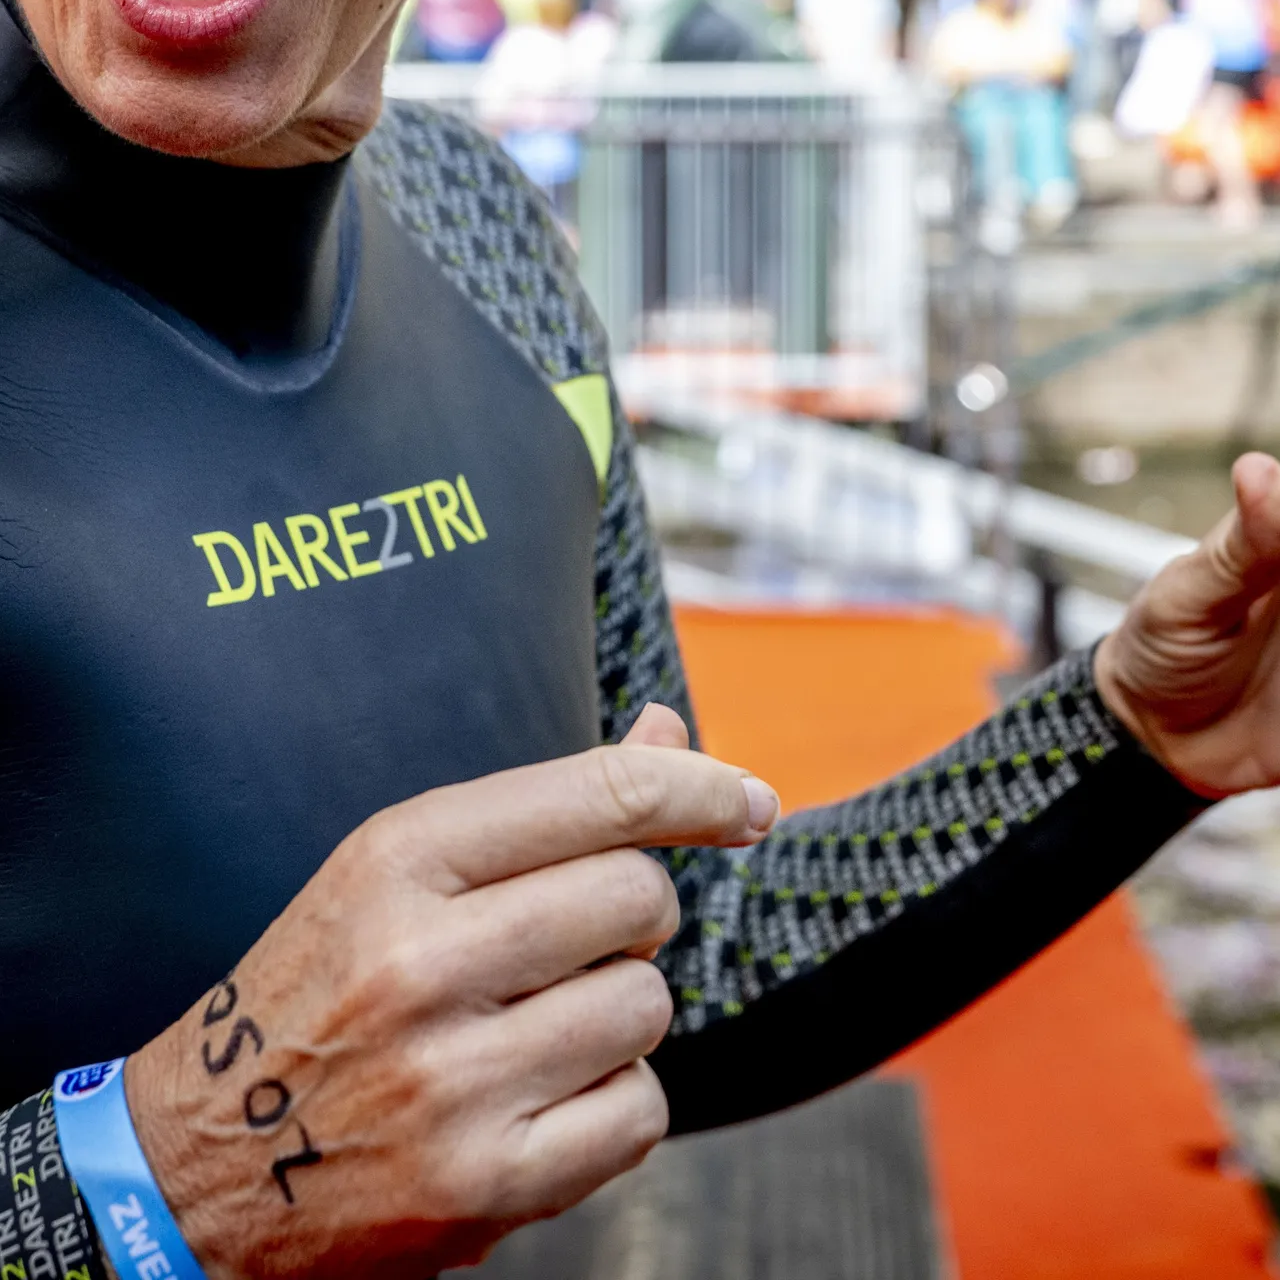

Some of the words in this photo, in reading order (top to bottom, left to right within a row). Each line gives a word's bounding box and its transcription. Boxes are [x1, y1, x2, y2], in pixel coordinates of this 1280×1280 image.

[191, 473, 488, 608] DARE2TRI
[8, 1122, 58, 1279] DARE2TRI
[108, 1193, 179, 1280] ZWE
